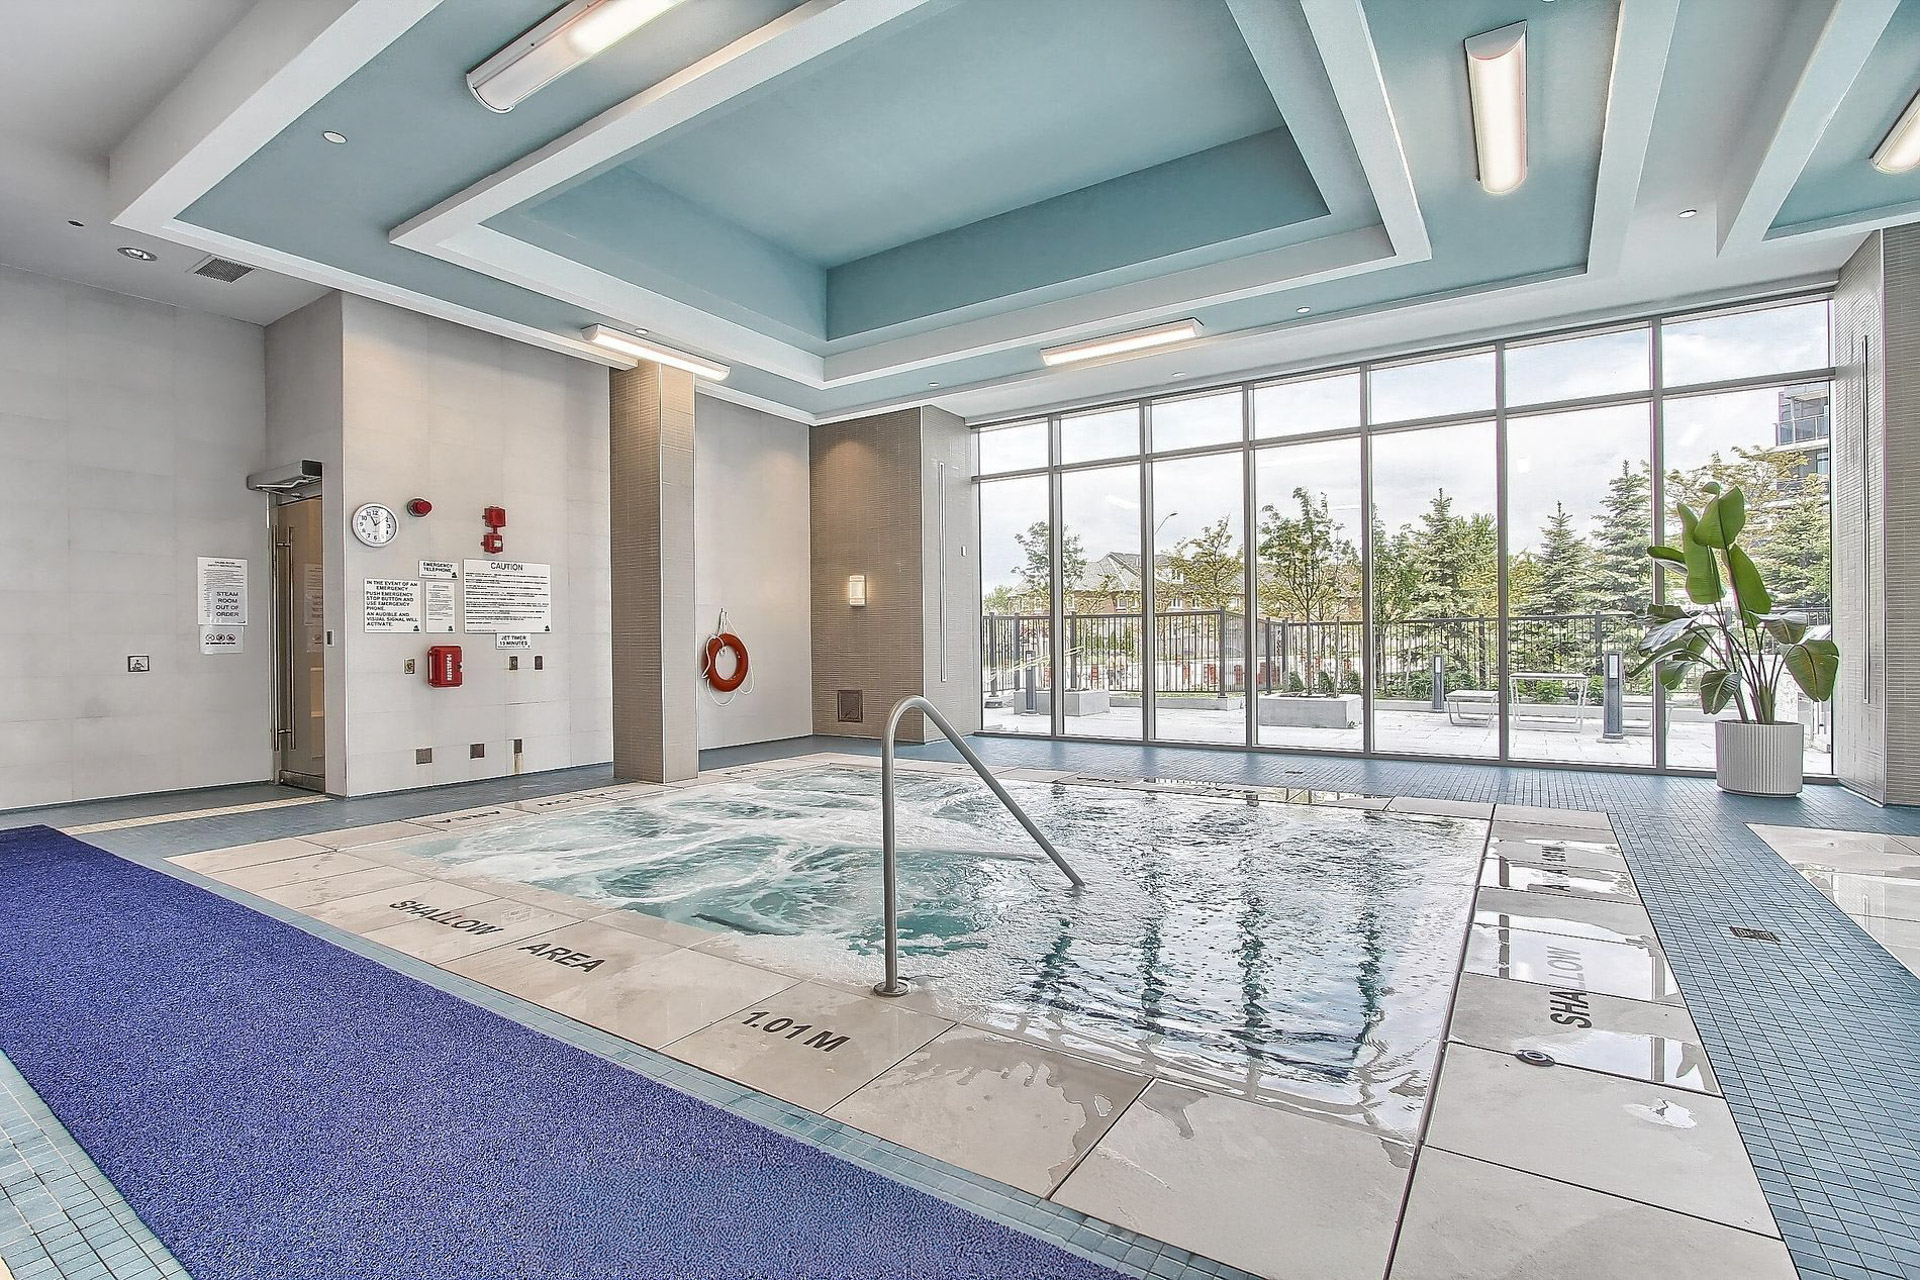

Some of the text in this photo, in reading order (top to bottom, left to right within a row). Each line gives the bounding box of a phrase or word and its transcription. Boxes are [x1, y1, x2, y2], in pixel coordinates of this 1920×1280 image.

[491, 562, 523, 570] CAUTION
[390, 900, 504, 936] SHALLOW
[517, 942, 605, 972] AREA
[1546, 945, 1592, 1029] SHALLOW
